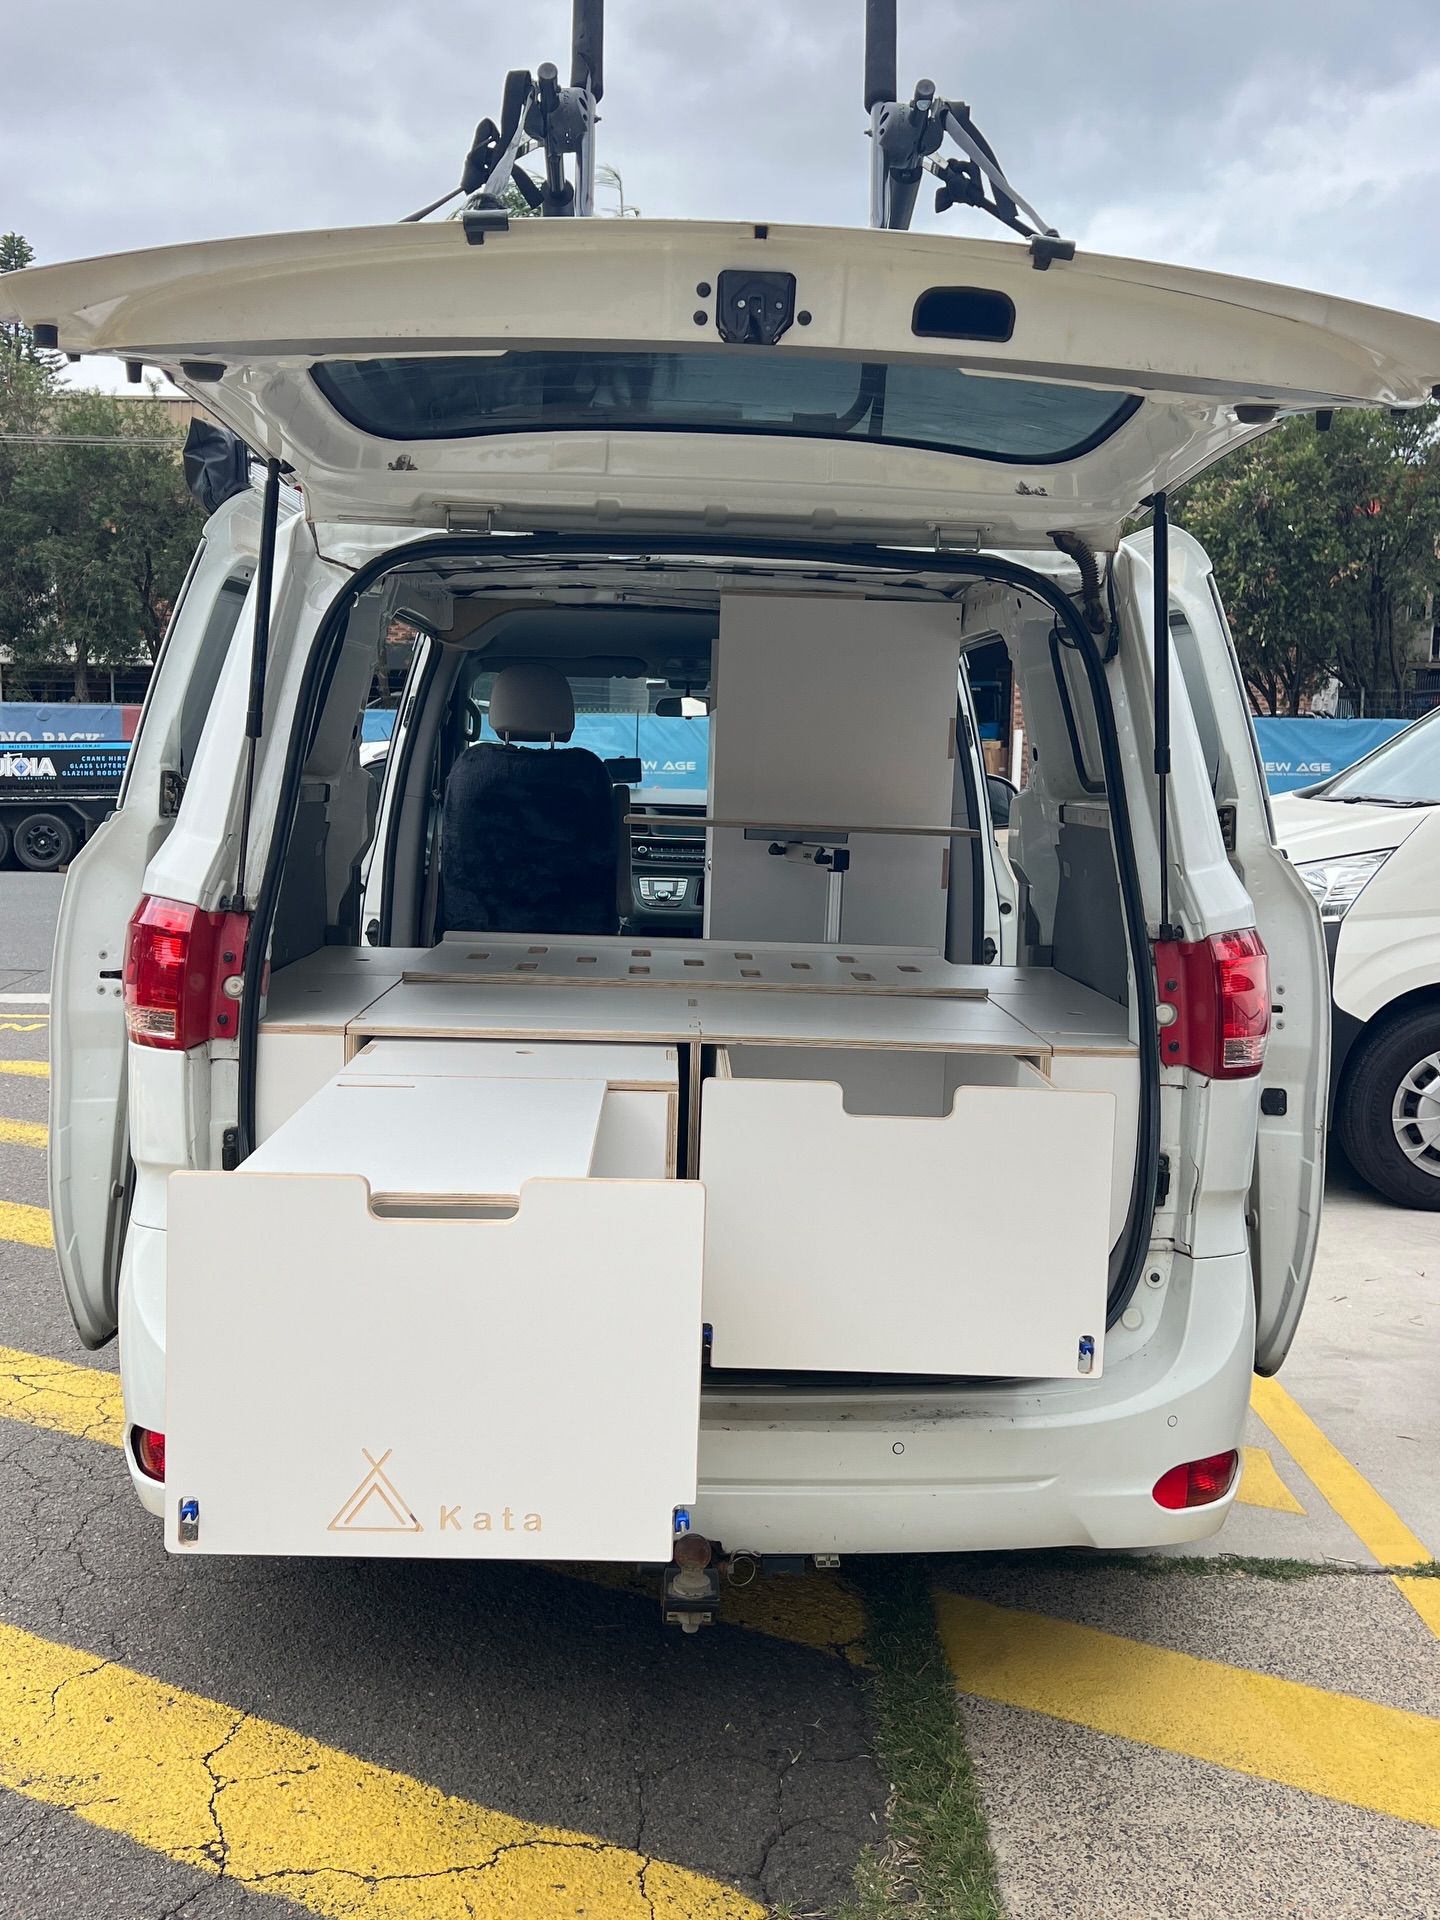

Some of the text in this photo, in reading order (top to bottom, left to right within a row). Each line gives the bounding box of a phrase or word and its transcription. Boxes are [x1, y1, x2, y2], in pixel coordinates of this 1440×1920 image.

[662, 761, 696, 770] AGE
[1296, 763, 1331, 772] AGE
[439, 1505, 542, 1532] Kata
